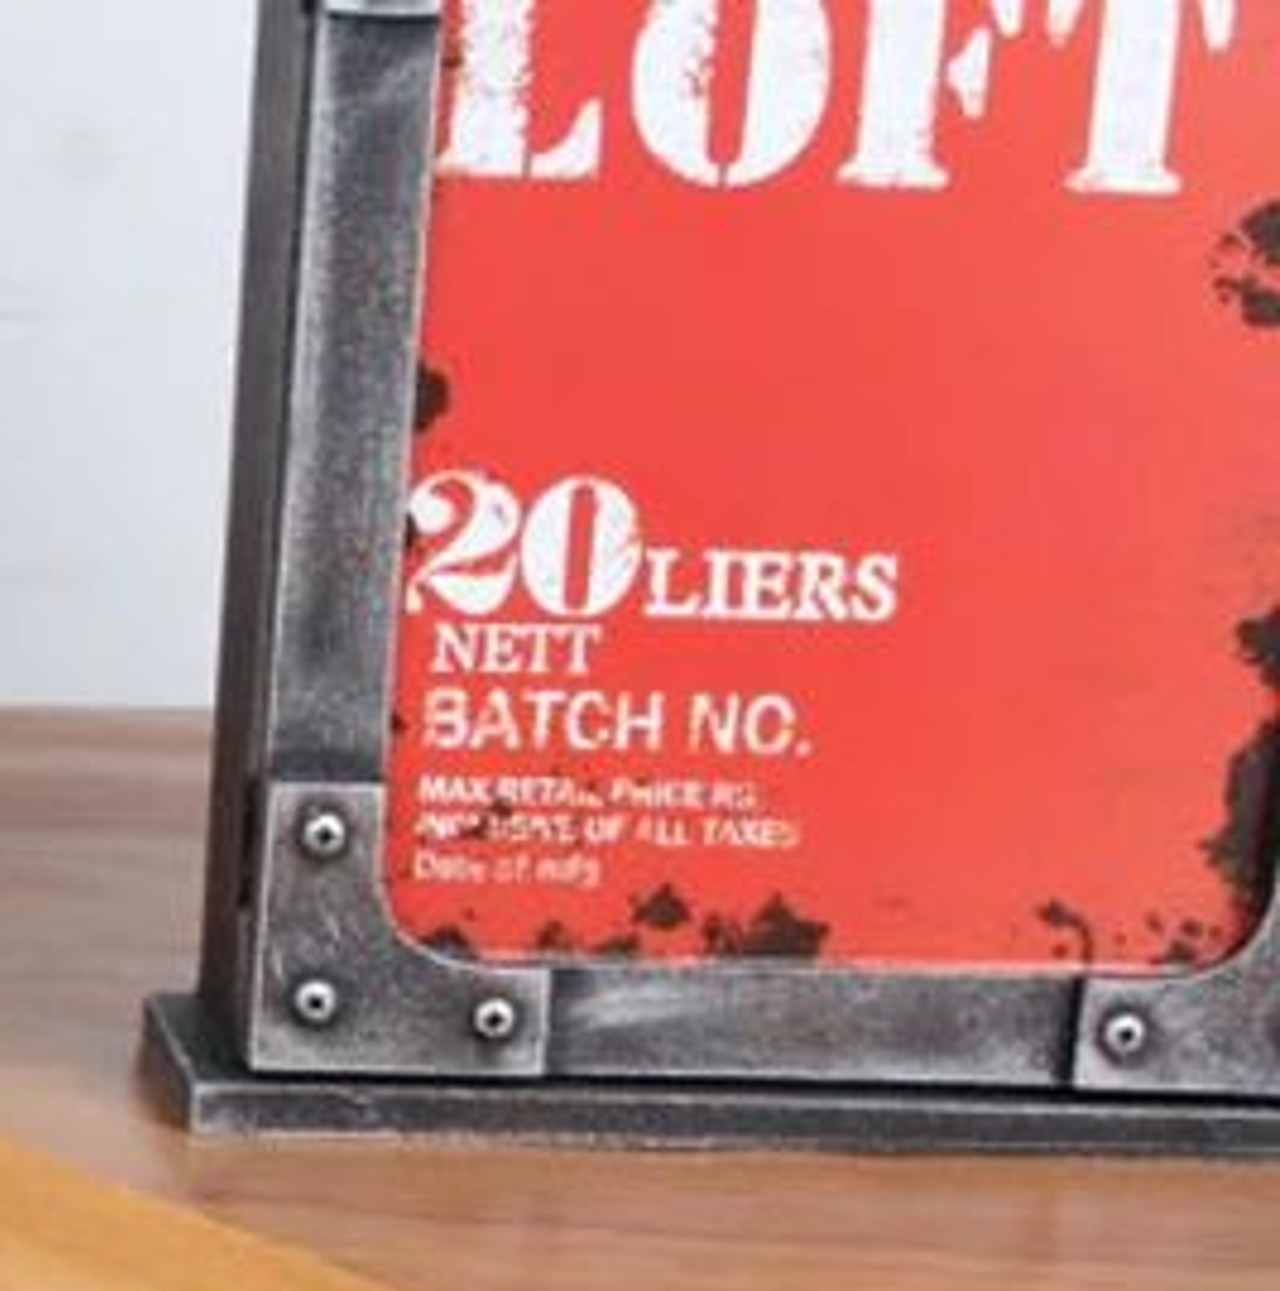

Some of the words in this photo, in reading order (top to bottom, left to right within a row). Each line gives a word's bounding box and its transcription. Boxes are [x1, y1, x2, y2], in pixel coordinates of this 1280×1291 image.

[435, 0, 1234, 193] LOFT
[406, 469, 642, 617] 20
[643, 547, 899, 622] LIERS
[432, 623, 602, 674] NETT
[422, 687, 663, 751] BATCH
[687, 694, 813, 756] NO.
